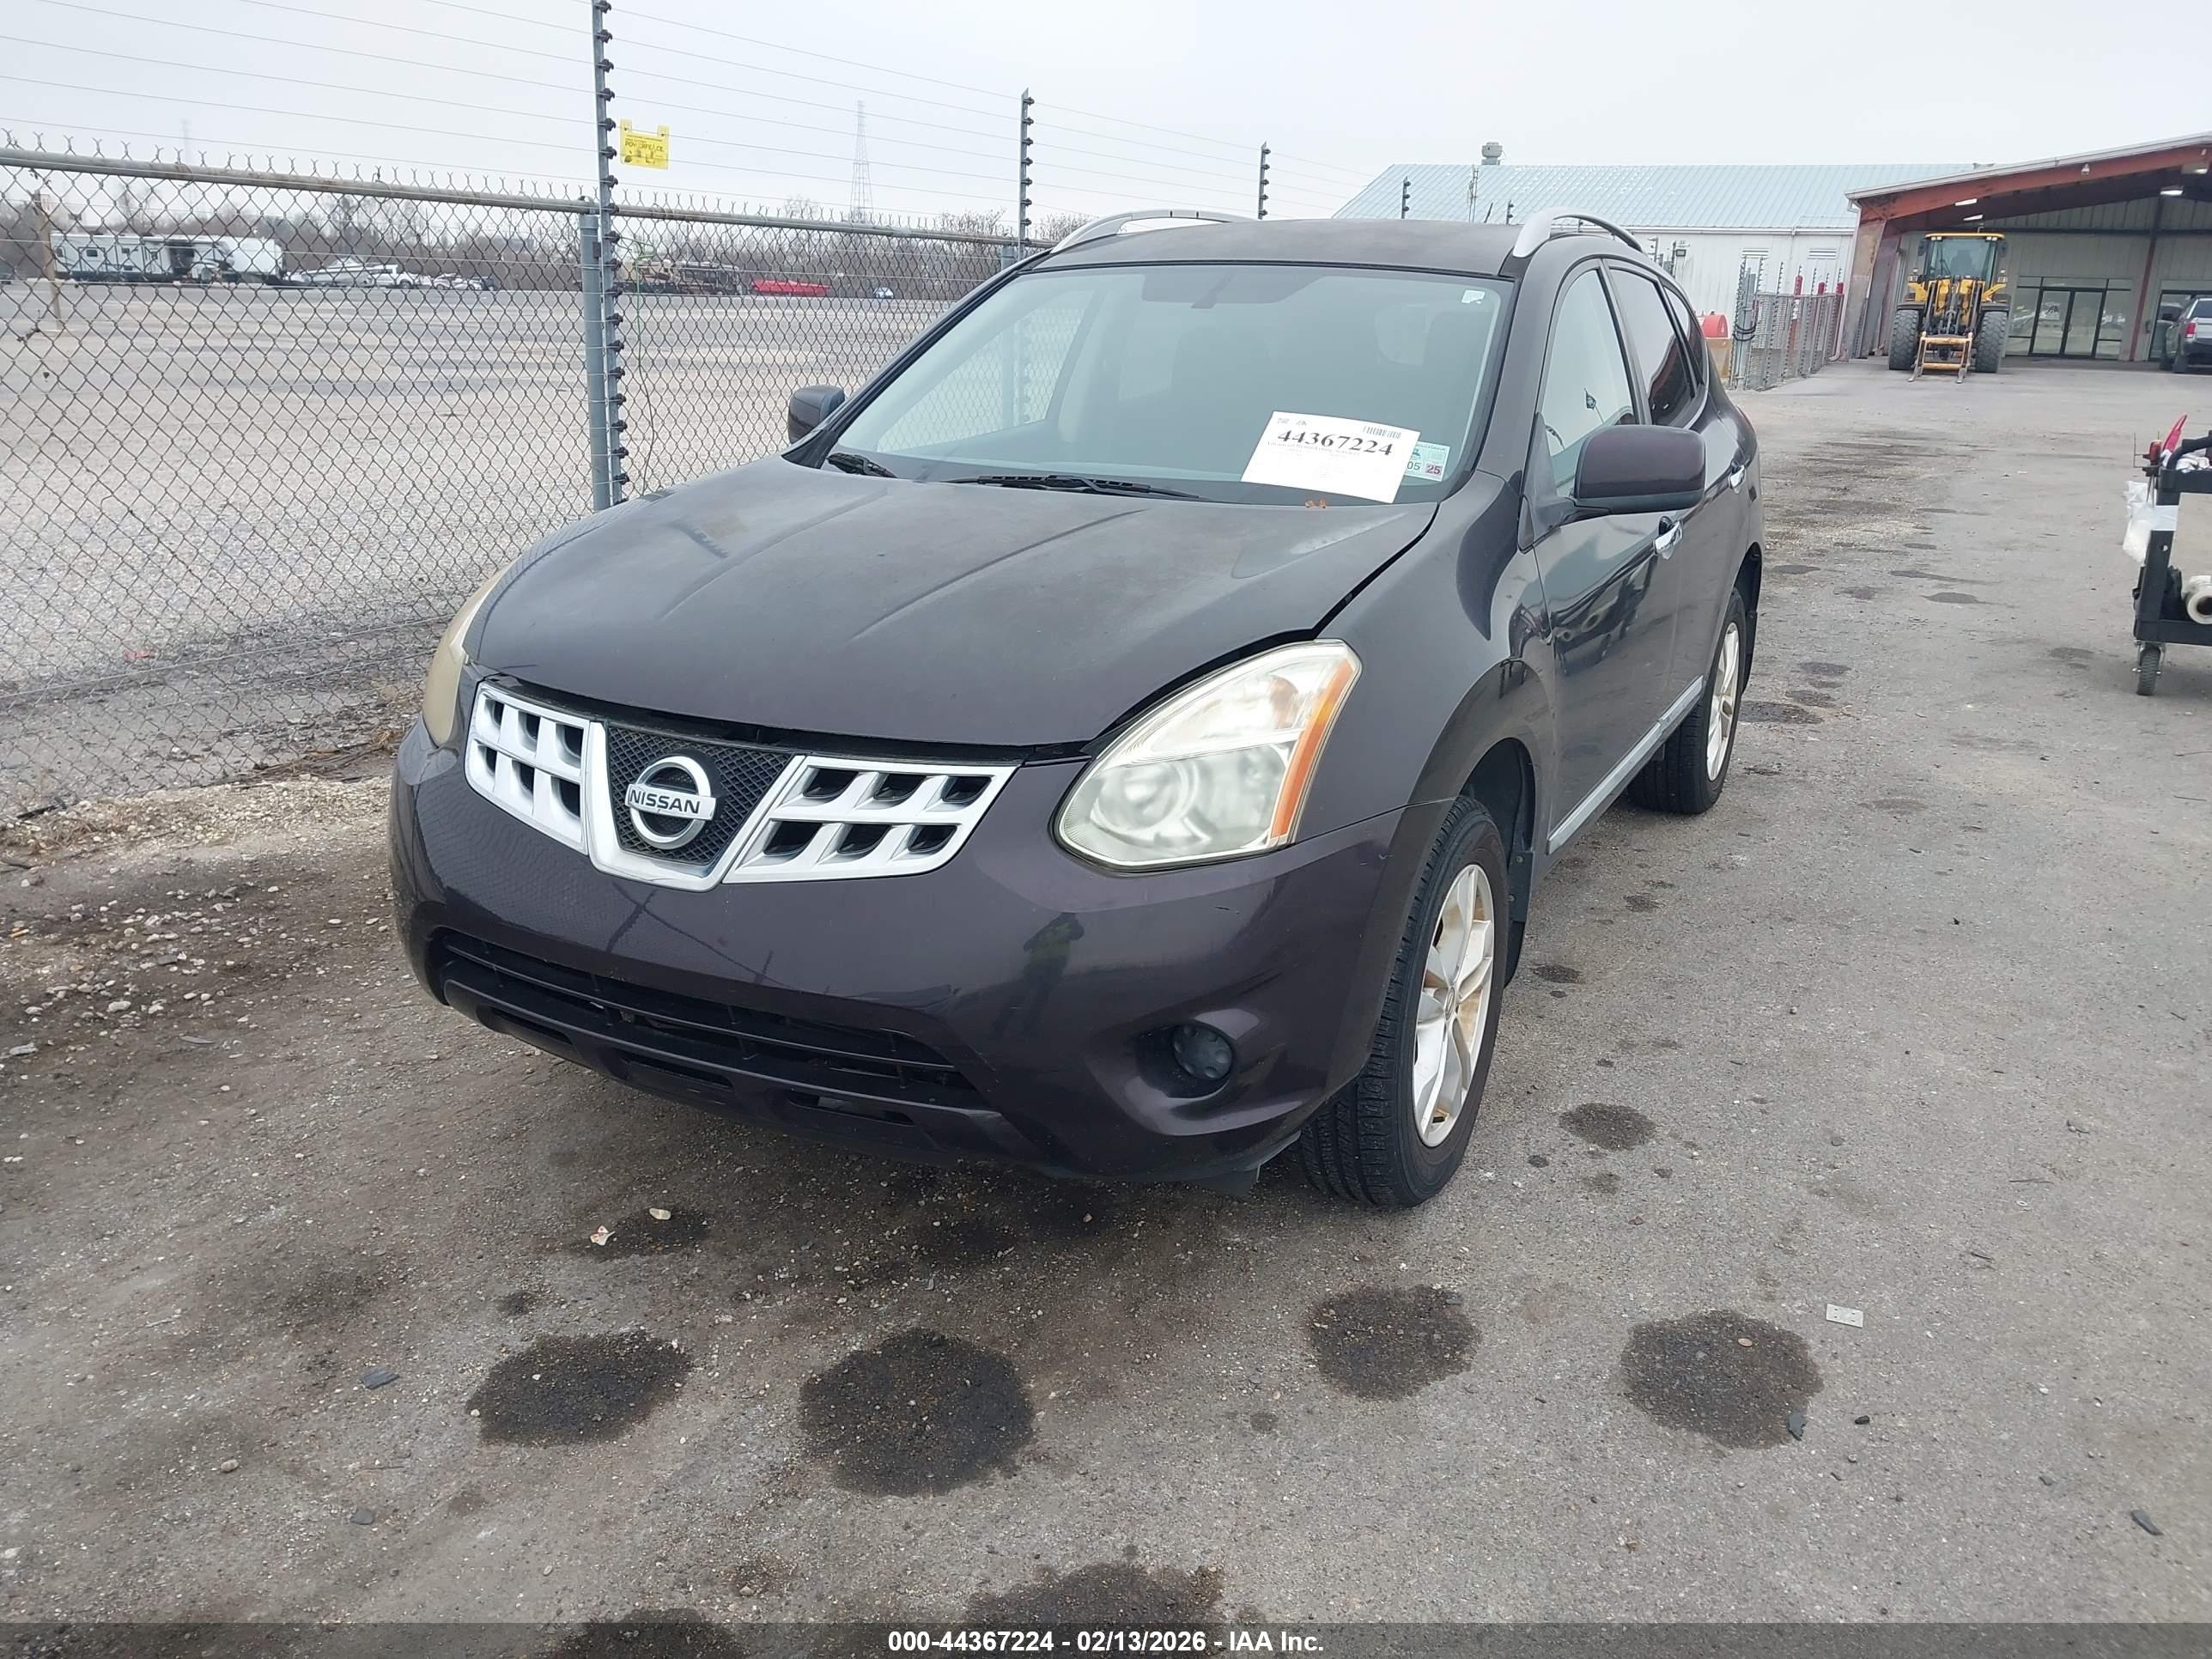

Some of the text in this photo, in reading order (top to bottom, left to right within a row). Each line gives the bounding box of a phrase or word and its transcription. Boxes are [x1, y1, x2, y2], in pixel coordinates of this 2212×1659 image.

[1277, 429, 1393, 456] 44367224
[1407, 461, 1441, 475] 05 25
[629, 789, 701, 814] NISSAN
